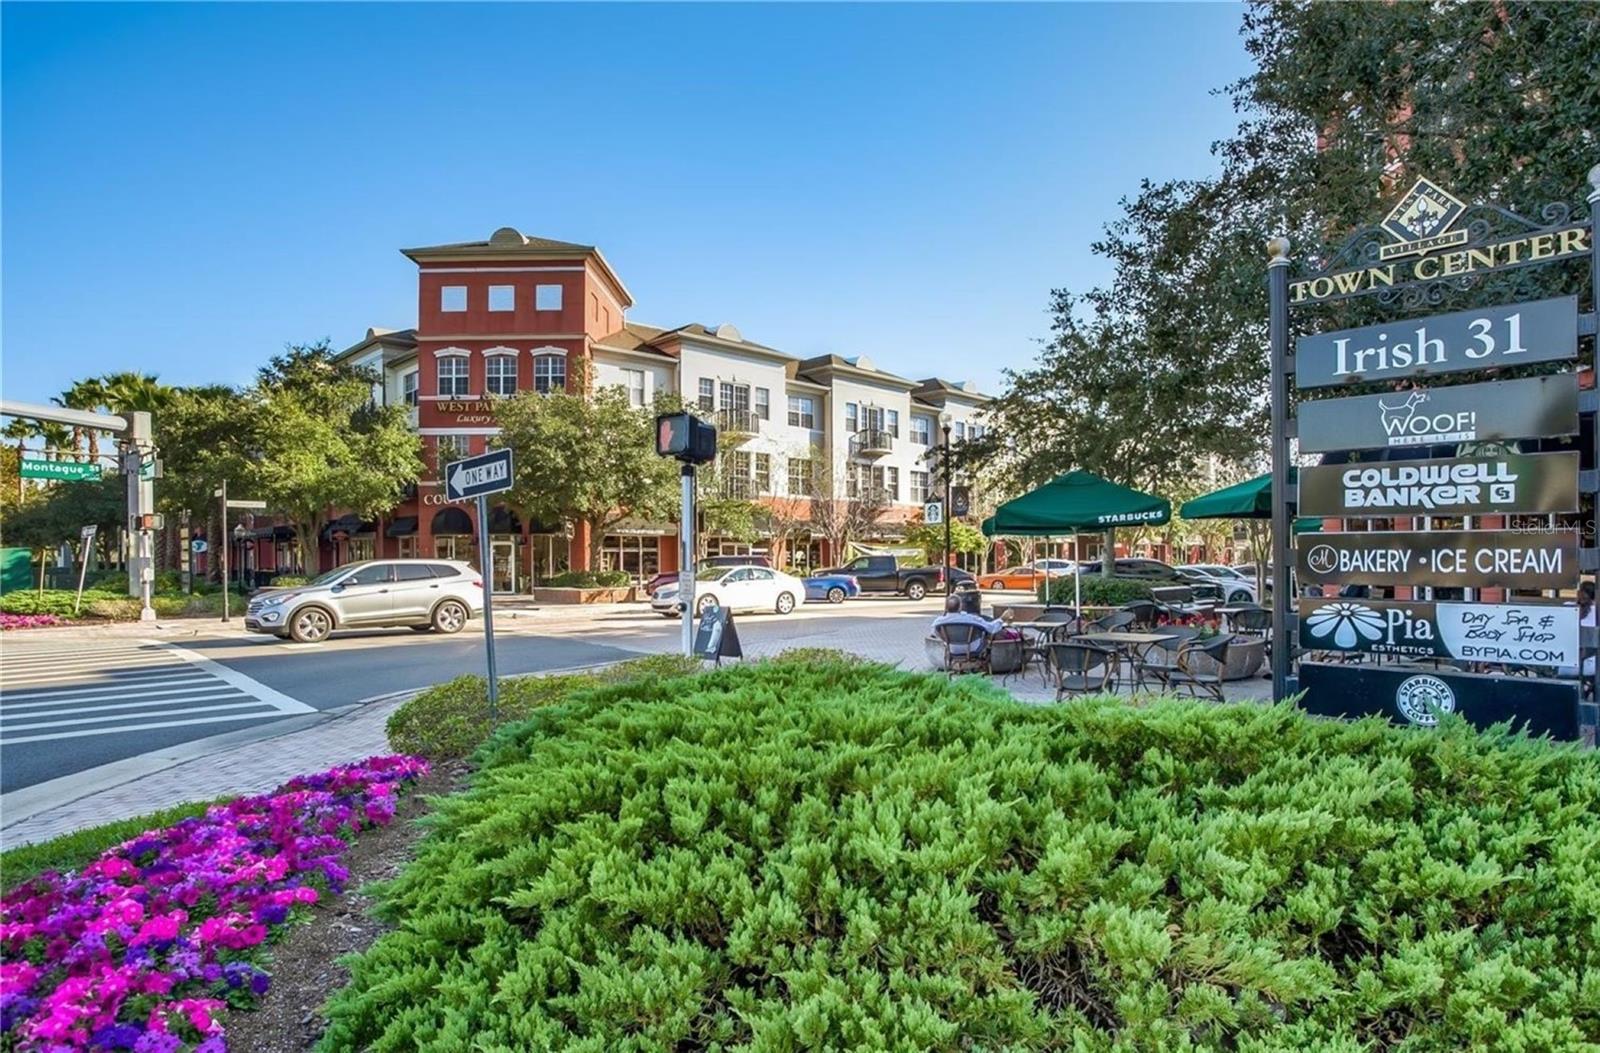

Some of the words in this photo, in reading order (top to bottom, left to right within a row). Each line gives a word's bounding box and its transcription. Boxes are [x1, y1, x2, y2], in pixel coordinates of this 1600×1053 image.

[1424, 187, 1454, 210] PARK
[1389, 235, 1456, 254] VILLAGE
[1289, 264, 1396, 302] TOWN
[1414, 228, 1589, 281] CENTER
[1332, 327, 1448, 376] Irish
[1465, 313, 1527, 359] 31
[437, 401, 472, 412] WEST
[475, 401, 496, 412] PA
[456, 414, 491, 425] Luxury
[1380, 411, 1476, 436] WOOF!
[465, 468, 483, 486] ONE
[485, 462, 505, 480] WAY
[1098, 510, 1163, 523] STARBUCKS
[1339, 549, 1411, 573] BAKERY
[1431, 548, 1467, 574] ICE
[1475, 548, 1563, 575] CREAM
[1386, 608, 1434, 645] Pia
[1462, 611, 1495, 626] DAY
[1464, 625, 1507, 641] BODY
[1513, 626, 1556, 643] SHOP
[1371, 644, 1434, 655] ESTHETICS
[1462, 645, 1564, 662] BYPIA.COM
[1400, 678, 1450, 700] STARBUCKS
